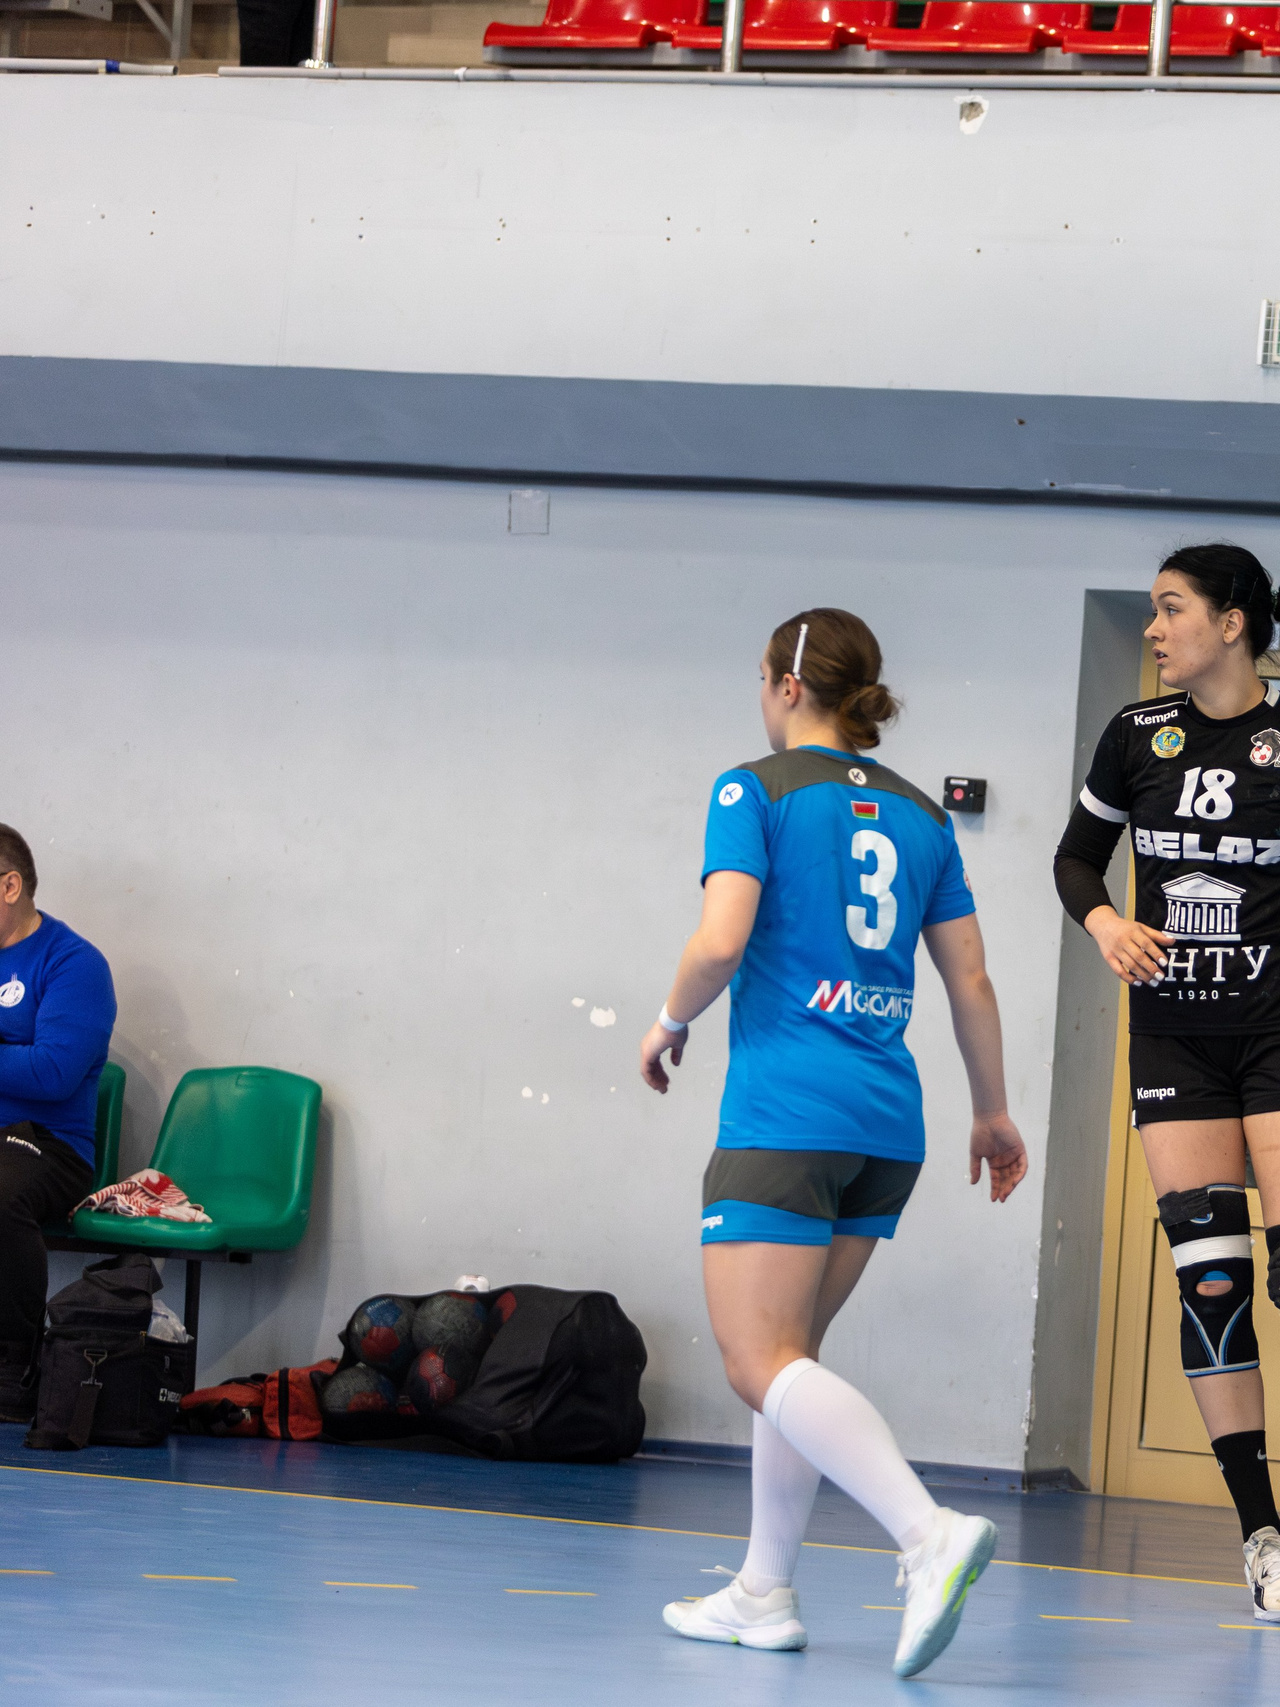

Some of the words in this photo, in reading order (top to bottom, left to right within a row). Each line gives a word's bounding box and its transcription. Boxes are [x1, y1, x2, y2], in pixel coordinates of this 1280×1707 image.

[1133, 709, 1178, 726] Kempa
[1174, 766, 1236, 821] 18
[845, 829, 898, 950] 3
[1164, 944, 1271, 982] НТУ
[1177, 989, 1219, 1000] 1920
[1136, 1087, 1176, 1100] Kempa
